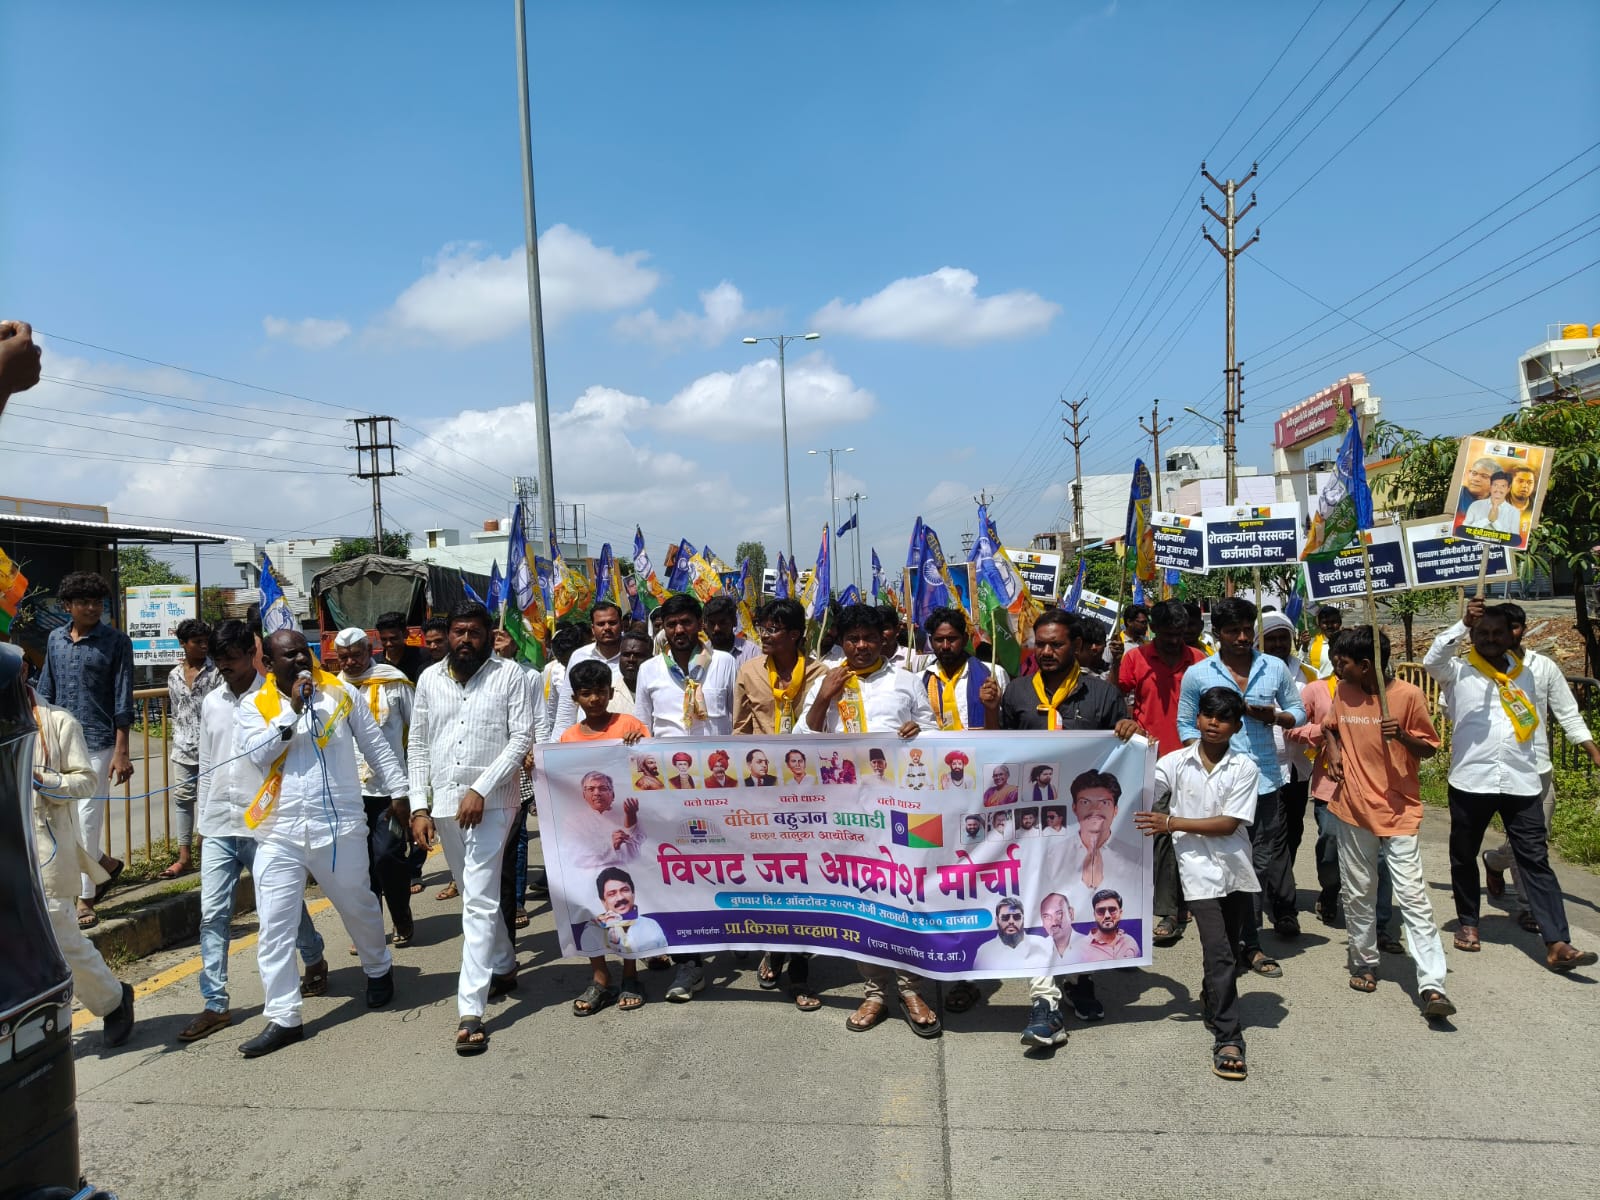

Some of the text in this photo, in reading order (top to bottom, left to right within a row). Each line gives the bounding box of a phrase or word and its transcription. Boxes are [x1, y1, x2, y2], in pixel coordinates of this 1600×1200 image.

[1257, 529, 1295, 541] सरसकट
[1220, 544, 1262, 559] कर्जमाफी
[722, 809, 885, 830] वंचित बहुजन आघाडी
[779, 830, 814, 843] तालुका
[819, 829, 865, 842] आयोजित
[657, 843, 1021, 905] विराट जन आक्रोश मोर्चा
[731, 895, 760, 907] बुधवार
[829, 899, 855, 910] २०२५
[946, 914, 978, 926] वाजता
[792, 924, 838, 939] चव्हाण
[840, 928, 861, 943] सर
